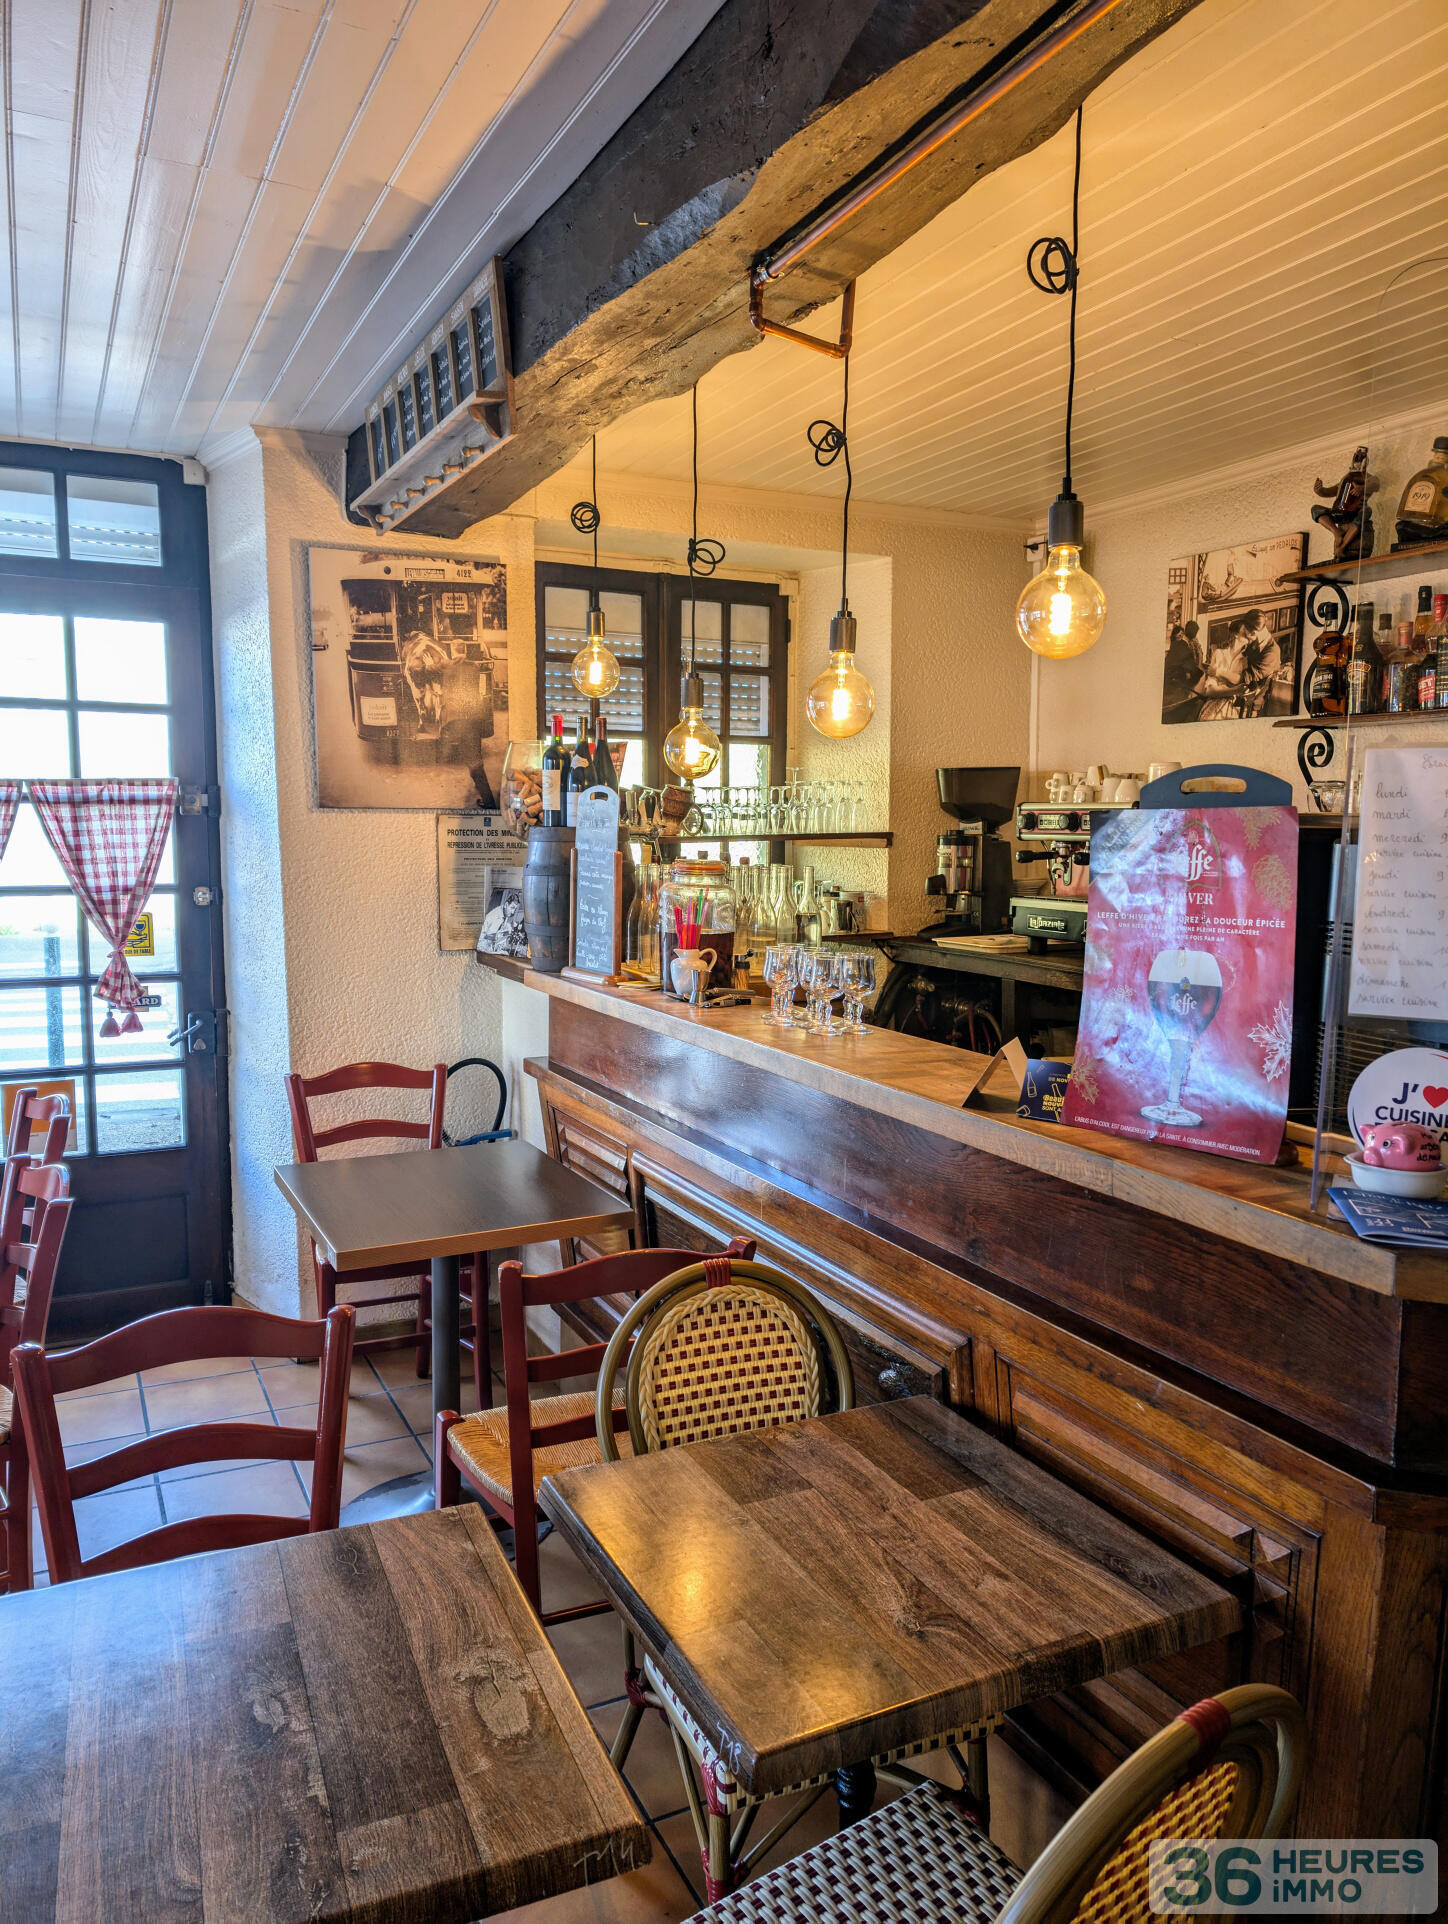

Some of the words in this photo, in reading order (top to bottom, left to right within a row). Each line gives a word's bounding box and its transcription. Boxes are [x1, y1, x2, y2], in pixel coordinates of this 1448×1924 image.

[447, 829, 484, 837] PROTECTION
[486, 829, 499, 837] DES
[1175, 844, 1214, 882] ffe
[1097, 911, 1119, 920] LEFFE
[1121, 912, 1154, 921] D'HIVE
[1213, 916, 1254, 927] DOUCEUR
[1255, 916, 1287, 929] ÉPICÉE
[134, 996, 159, 1006] ARD
[1391, 1082, 1420, 1105] J'
